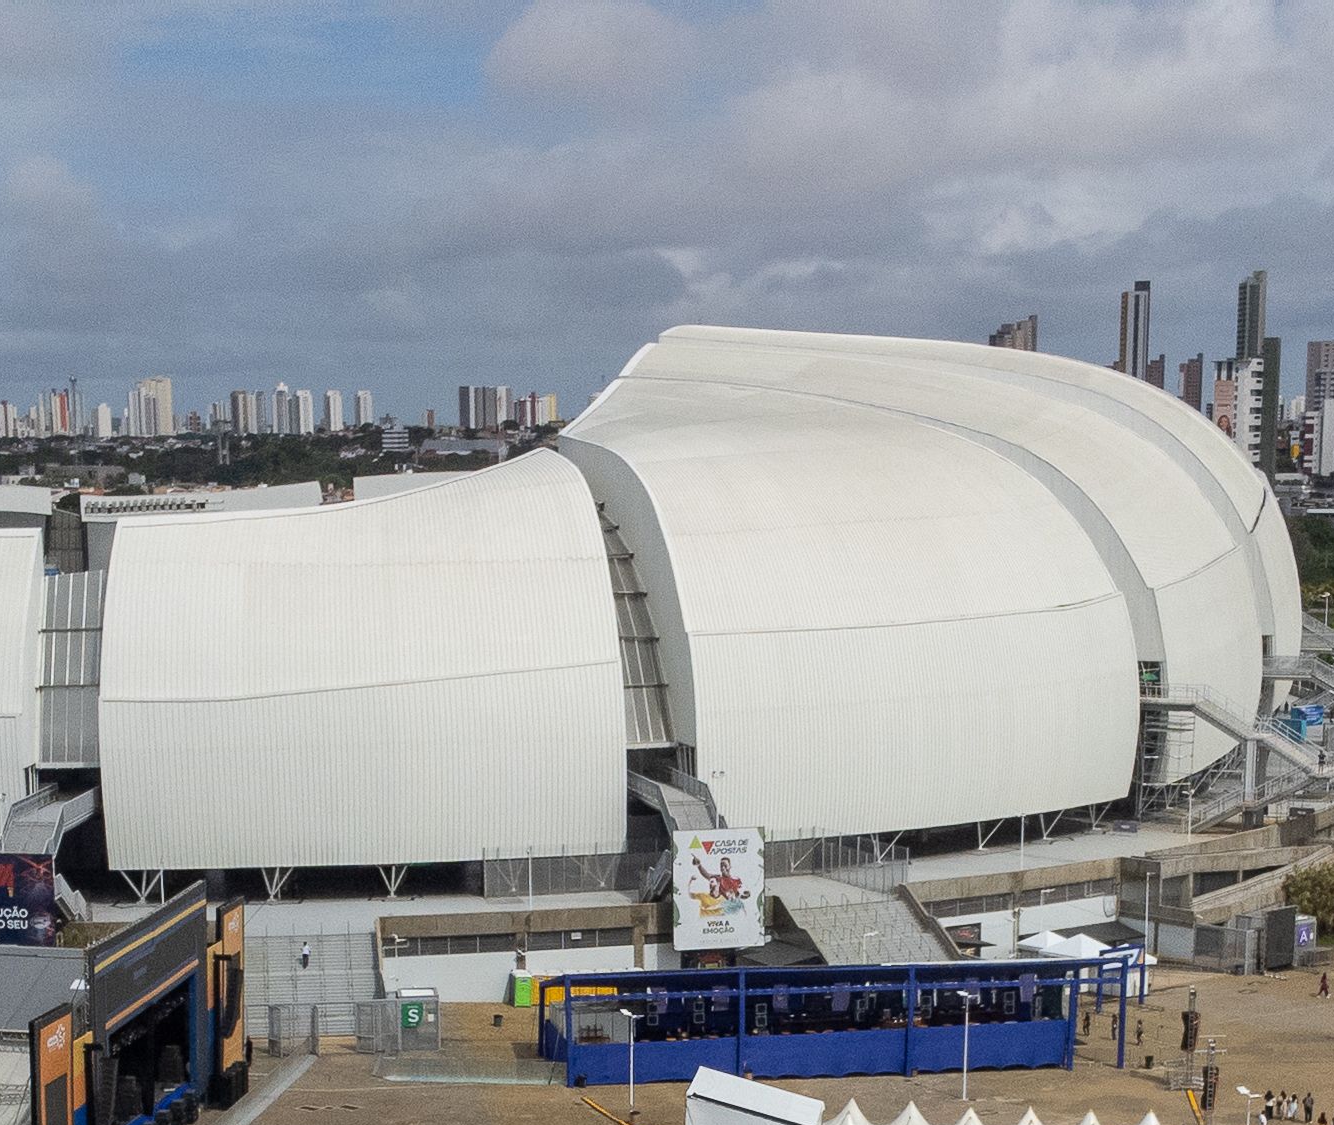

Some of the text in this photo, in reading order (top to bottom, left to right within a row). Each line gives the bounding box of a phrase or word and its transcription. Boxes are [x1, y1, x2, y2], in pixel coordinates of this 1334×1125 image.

[715, 839, 736, 847] CASA
[710, 846, 748, 855] APOSTAS
[7, 919, 29, 930] SEU
[702, 926, 735, 935] EMOÇÃO
[1299, 930, 1308, 943] A
[408, 1008, 419, 1023] S
